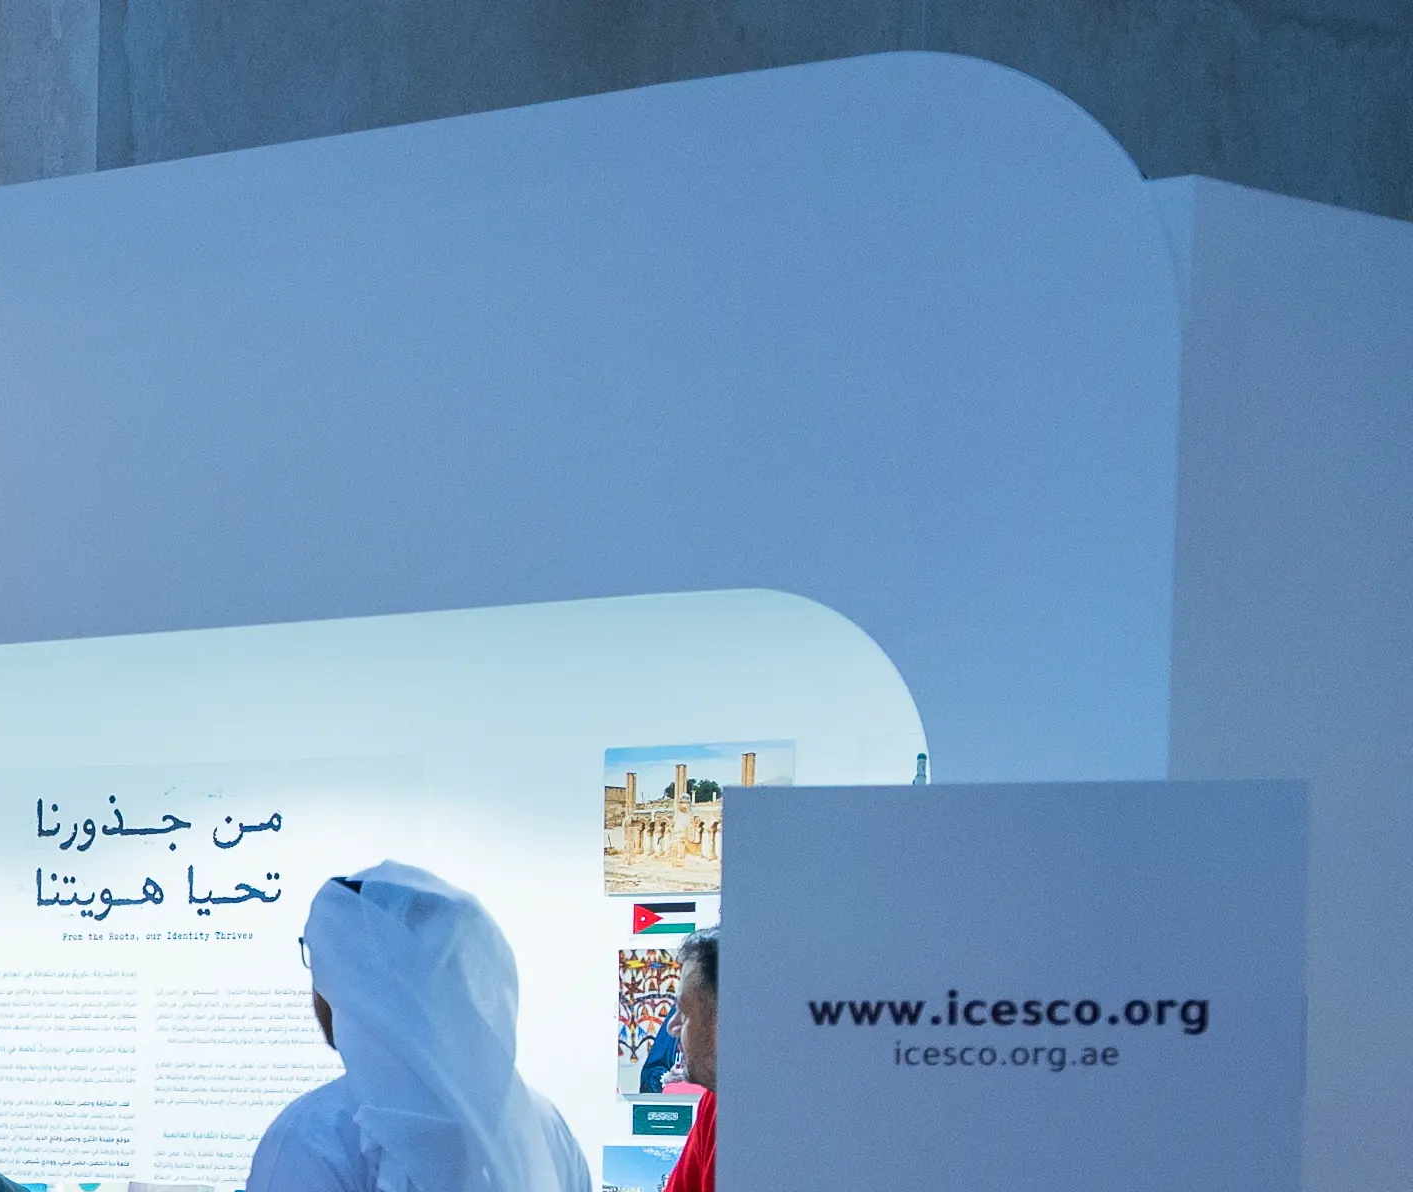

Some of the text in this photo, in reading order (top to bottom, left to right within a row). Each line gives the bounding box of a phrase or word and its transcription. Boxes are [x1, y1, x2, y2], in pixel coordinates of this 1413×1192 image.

[36, 794, 283, 852] من جذورنا
[35, 864, 282, 922] تحيا هويتنا
[62, 931, 254, 942] From the Roots, our Identity Thrives
[808, 988, 1210, 1035] www.icesco.org
[893, 1039, 1120, 1073] icesco.org.ae
